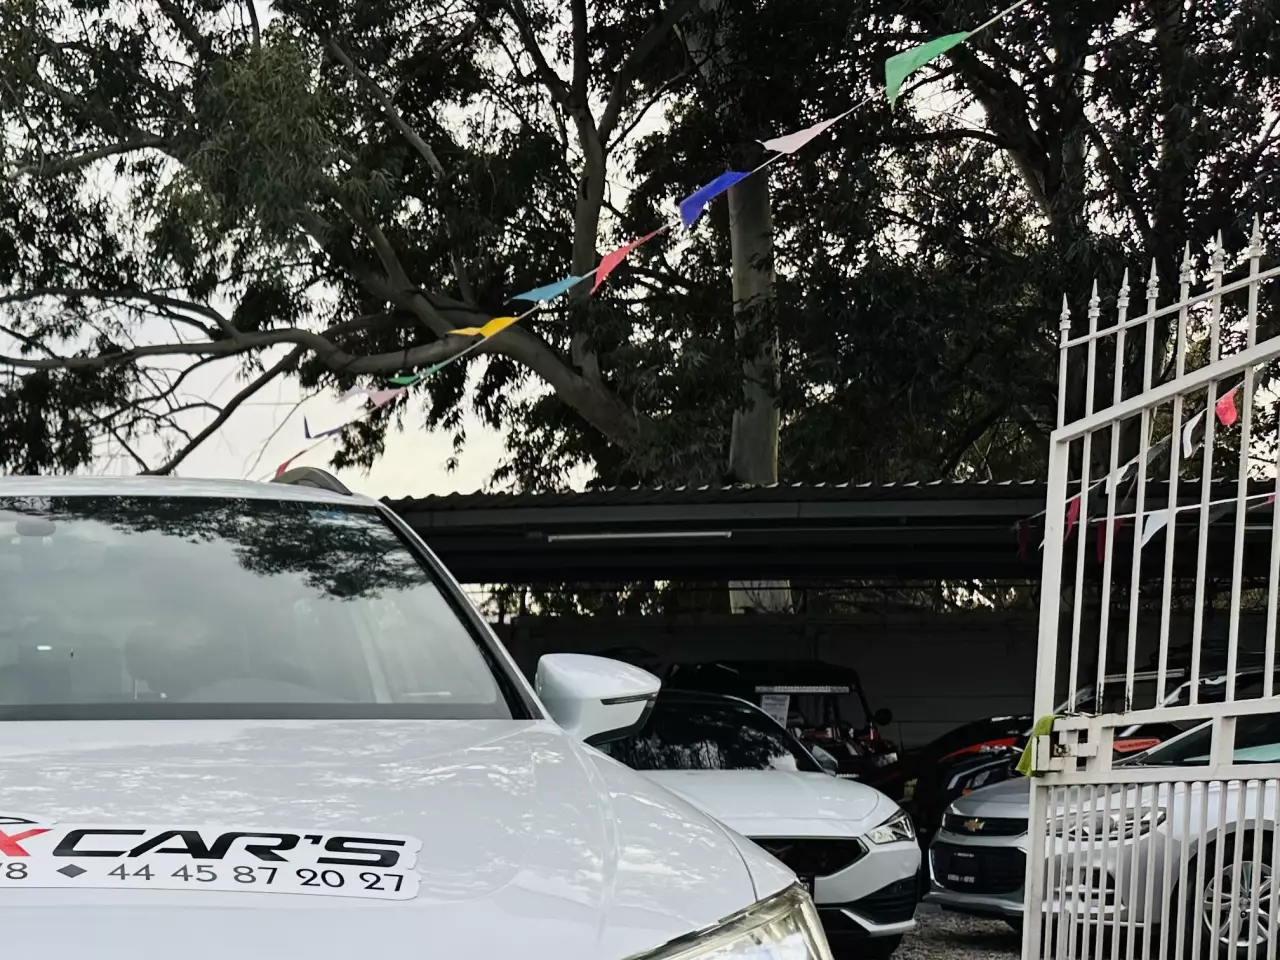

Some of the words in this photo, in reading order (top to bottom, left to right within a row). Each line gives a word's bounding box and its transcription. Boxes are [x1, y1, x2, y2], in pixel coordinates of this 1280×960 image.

[107, 863, 155, 880] 44
[170, 864, 218, 882] 45
[233, 866, 278, 885] 87
[296, 868, 345, 888] 20
[359, 871, 404, 892] 27
